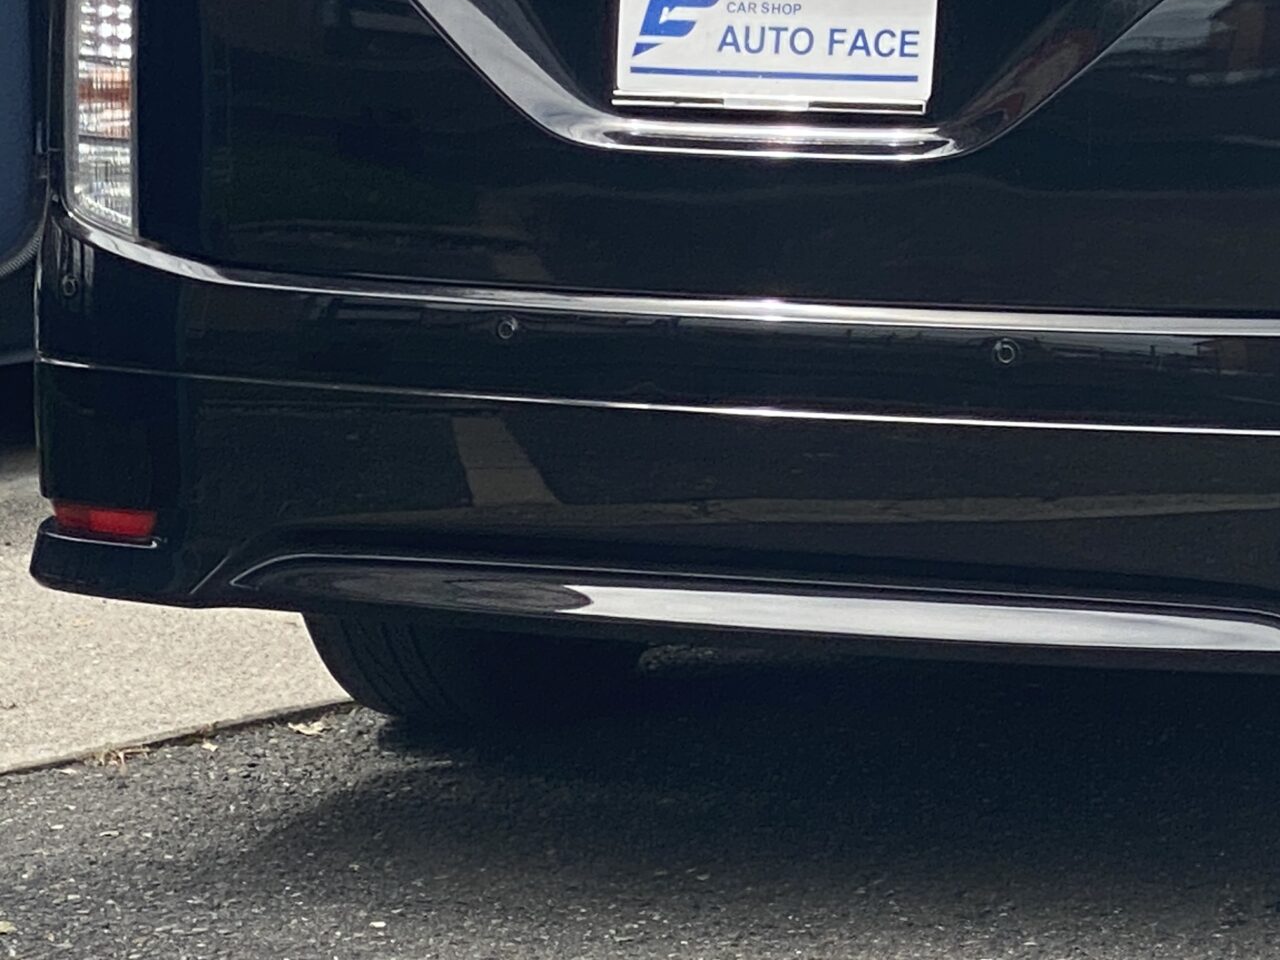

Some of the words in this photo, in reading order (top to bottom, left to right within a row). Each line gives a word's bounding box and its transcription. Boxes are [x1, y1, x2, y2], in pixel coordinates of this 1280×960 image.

[726, 1, 757, 14] CAR
[761, 1, 802, 15] SHOP
[717, 24, 814, 55] AUTO
[828, 28, 920, 58] FACE
